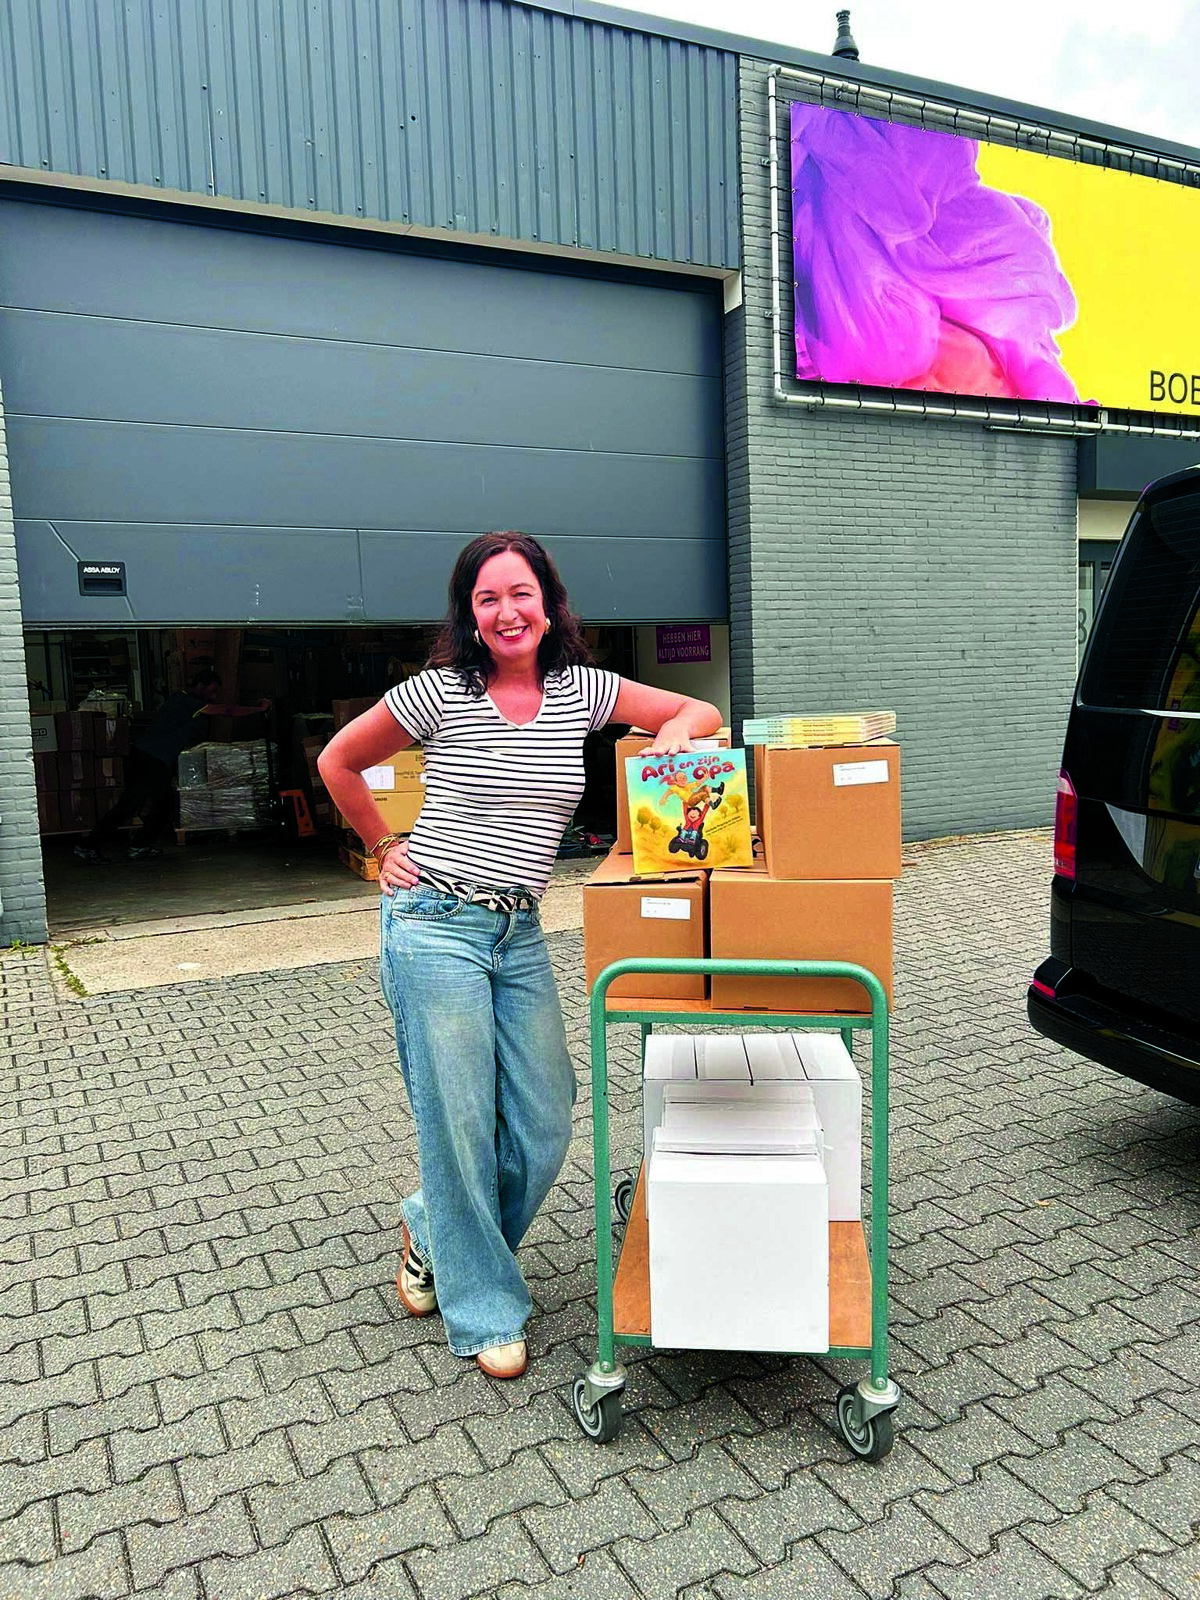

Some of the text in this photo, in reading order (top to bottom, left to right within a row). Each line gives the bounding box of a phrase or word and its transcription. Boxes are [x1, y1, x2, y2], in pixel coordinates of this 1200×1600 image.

[1150, 370, 1200, 405] BOE
[662, 630, 702, 644] HEBBEN HIER
[676, 645, 710, 657] VOORRANG
[641, 755, 720, 781] Ari en zijn
